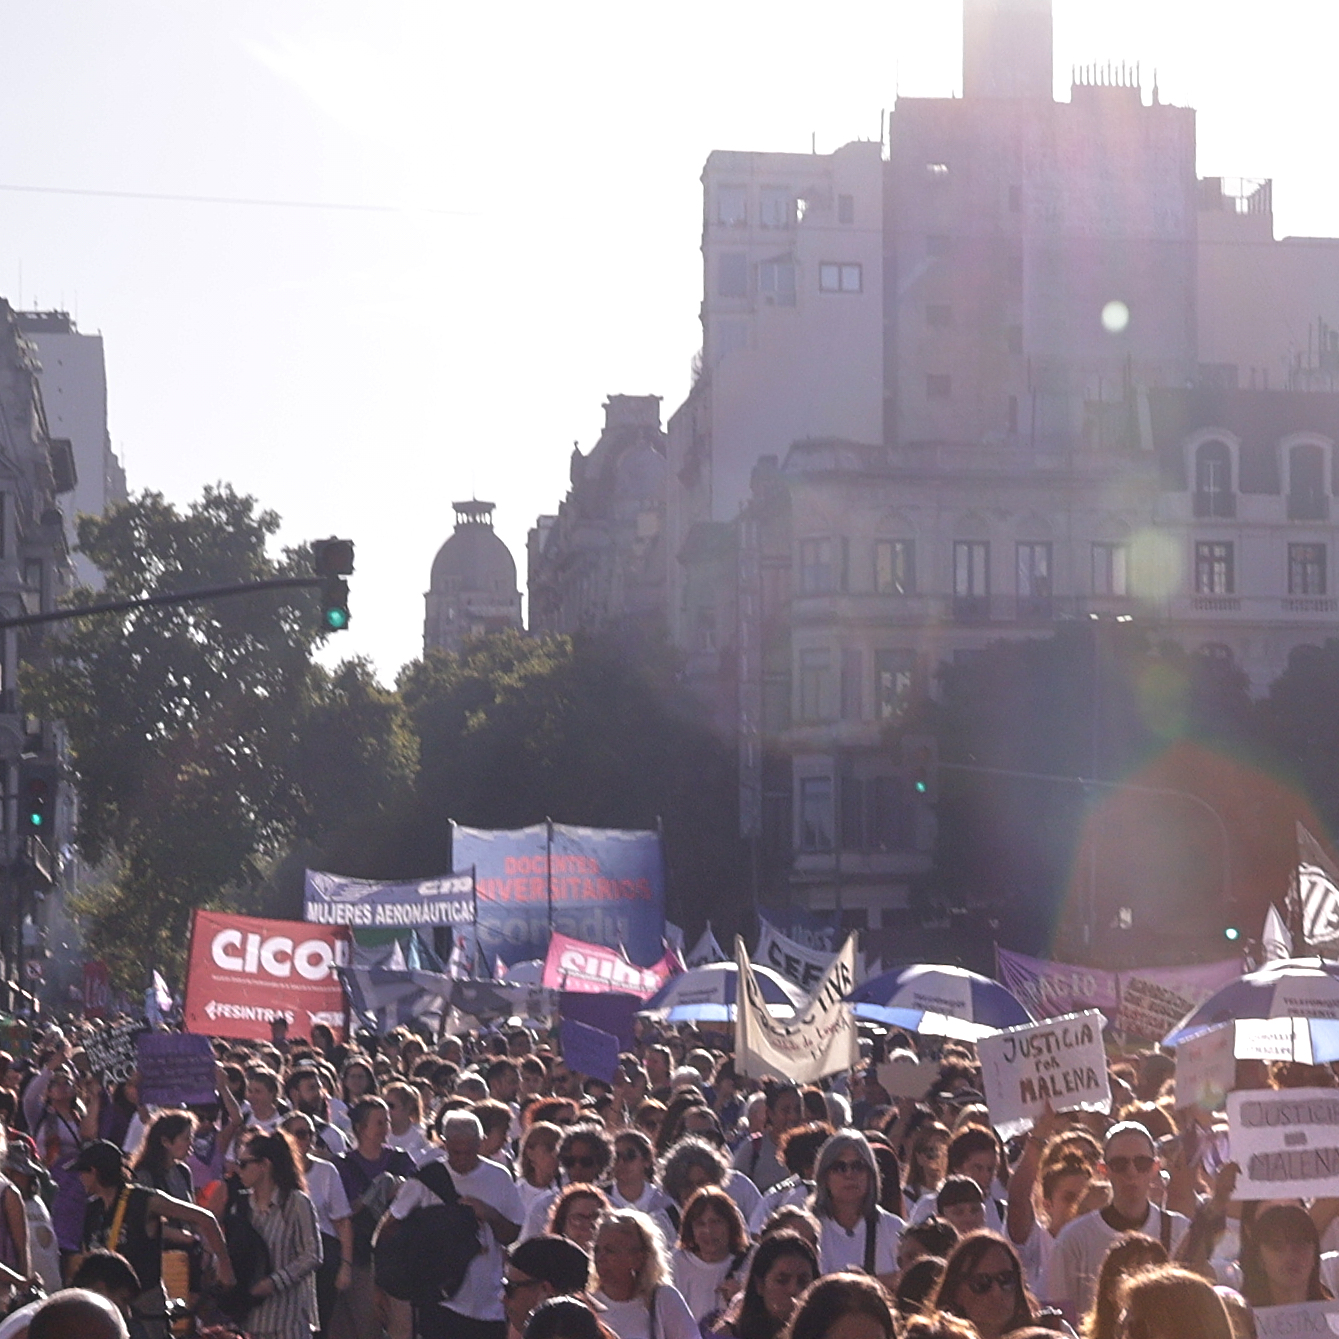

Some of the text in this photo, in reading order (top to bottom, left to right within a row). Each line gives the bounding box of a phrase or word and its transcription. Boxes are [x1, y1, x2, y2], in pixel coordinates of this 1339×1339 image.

[505, 855, 600, 875] DOCENTES
[306, 901, 372, 924] MUJERES
[1002, 1023, 1094, 1064] JUSTICIA
[1019, 1066, 1099, 1105] MALENA
